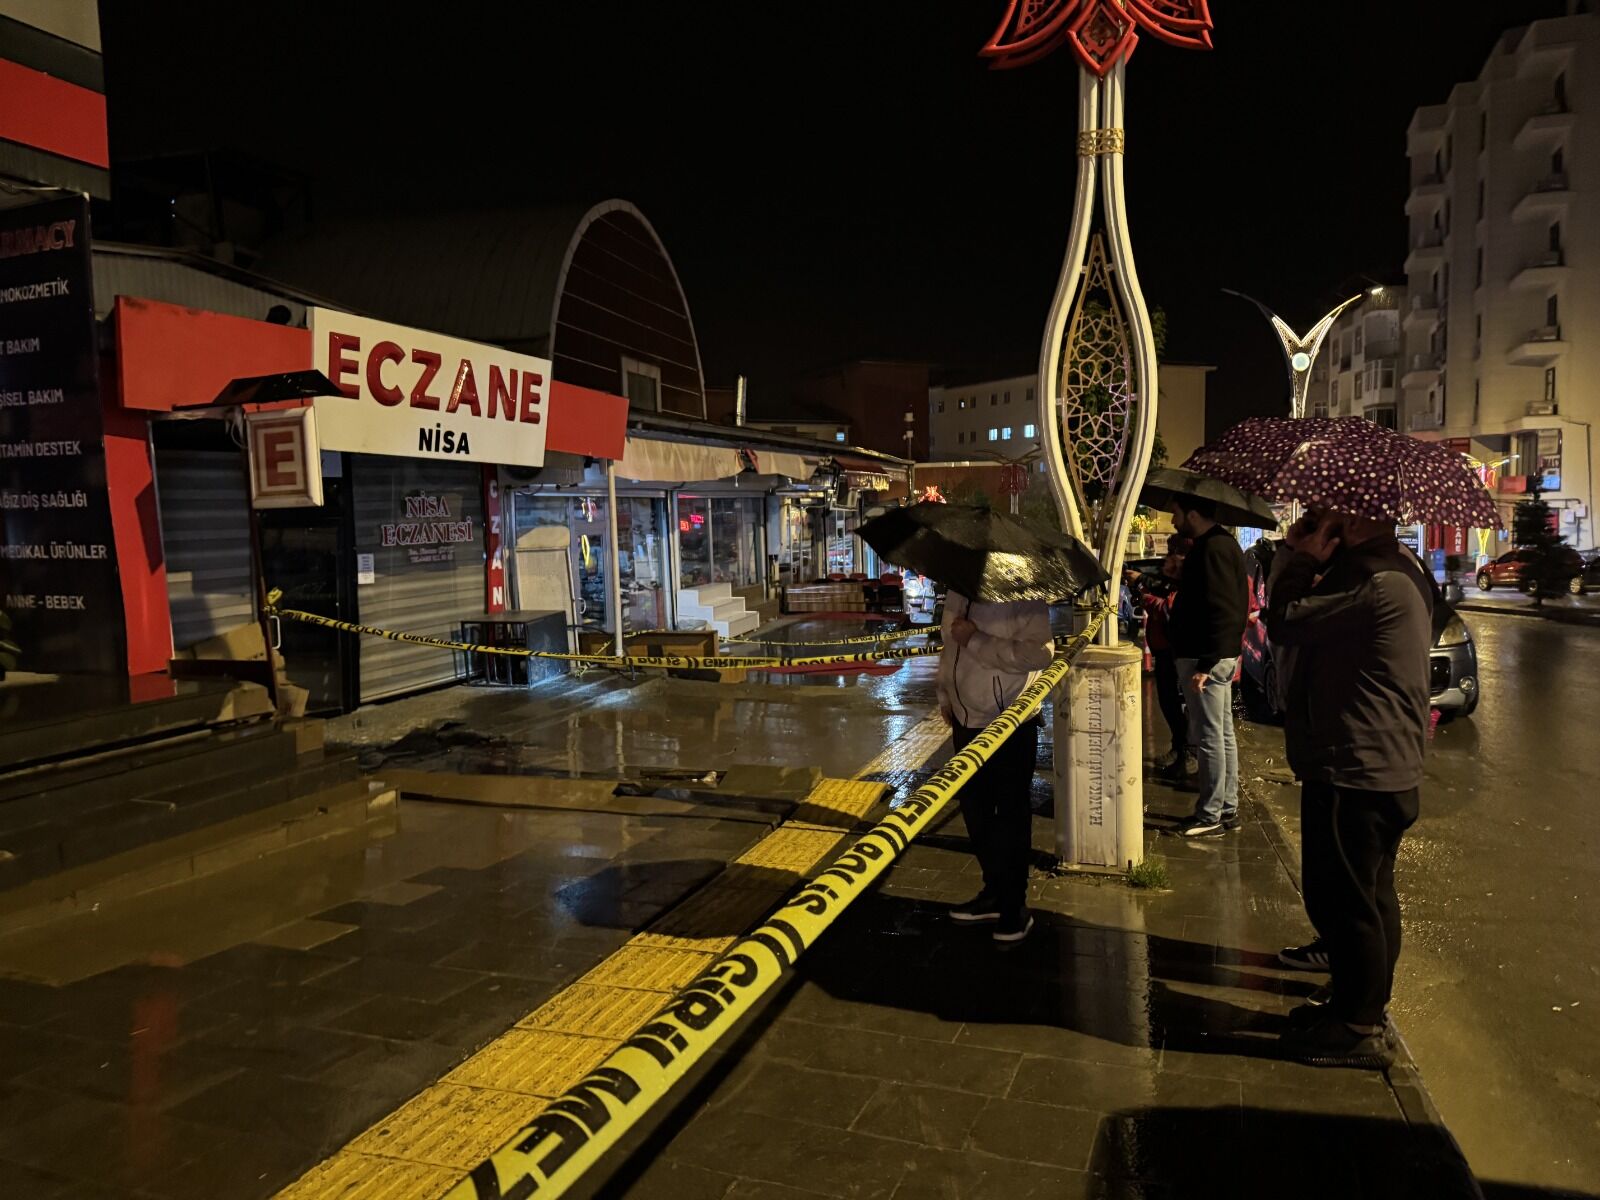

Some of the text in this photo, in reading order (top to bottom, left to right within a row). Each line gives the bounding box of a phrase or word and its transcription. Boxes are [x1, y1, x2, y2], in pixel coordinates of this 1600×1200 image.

[6, 337, 40, 355] BAKIM
[329, 332, 543, 424] ECZANE
[28, 388, 64, 405] BAKIM
[35, 440, 82, 456] DESTEK
[419, 423, 470, 454] NİSA
[264, 431, 297, 486] E
[21, 490, 40, 511] DİŞ
[41, 489, 88, 508] SAĞLIĞI
[405, 490, 451, 518] NİSA
[381, 516, 474, 546] ECZANESİ
[50, 540, 108, 559] ÜRÜNLER
[6, 594, 36, 609] ANNE
[45, 594, 86, 610] BEBEK
[1086, 760, 1103, 827] HAKKARİ
[786, 842, 884, 915] POLİS
